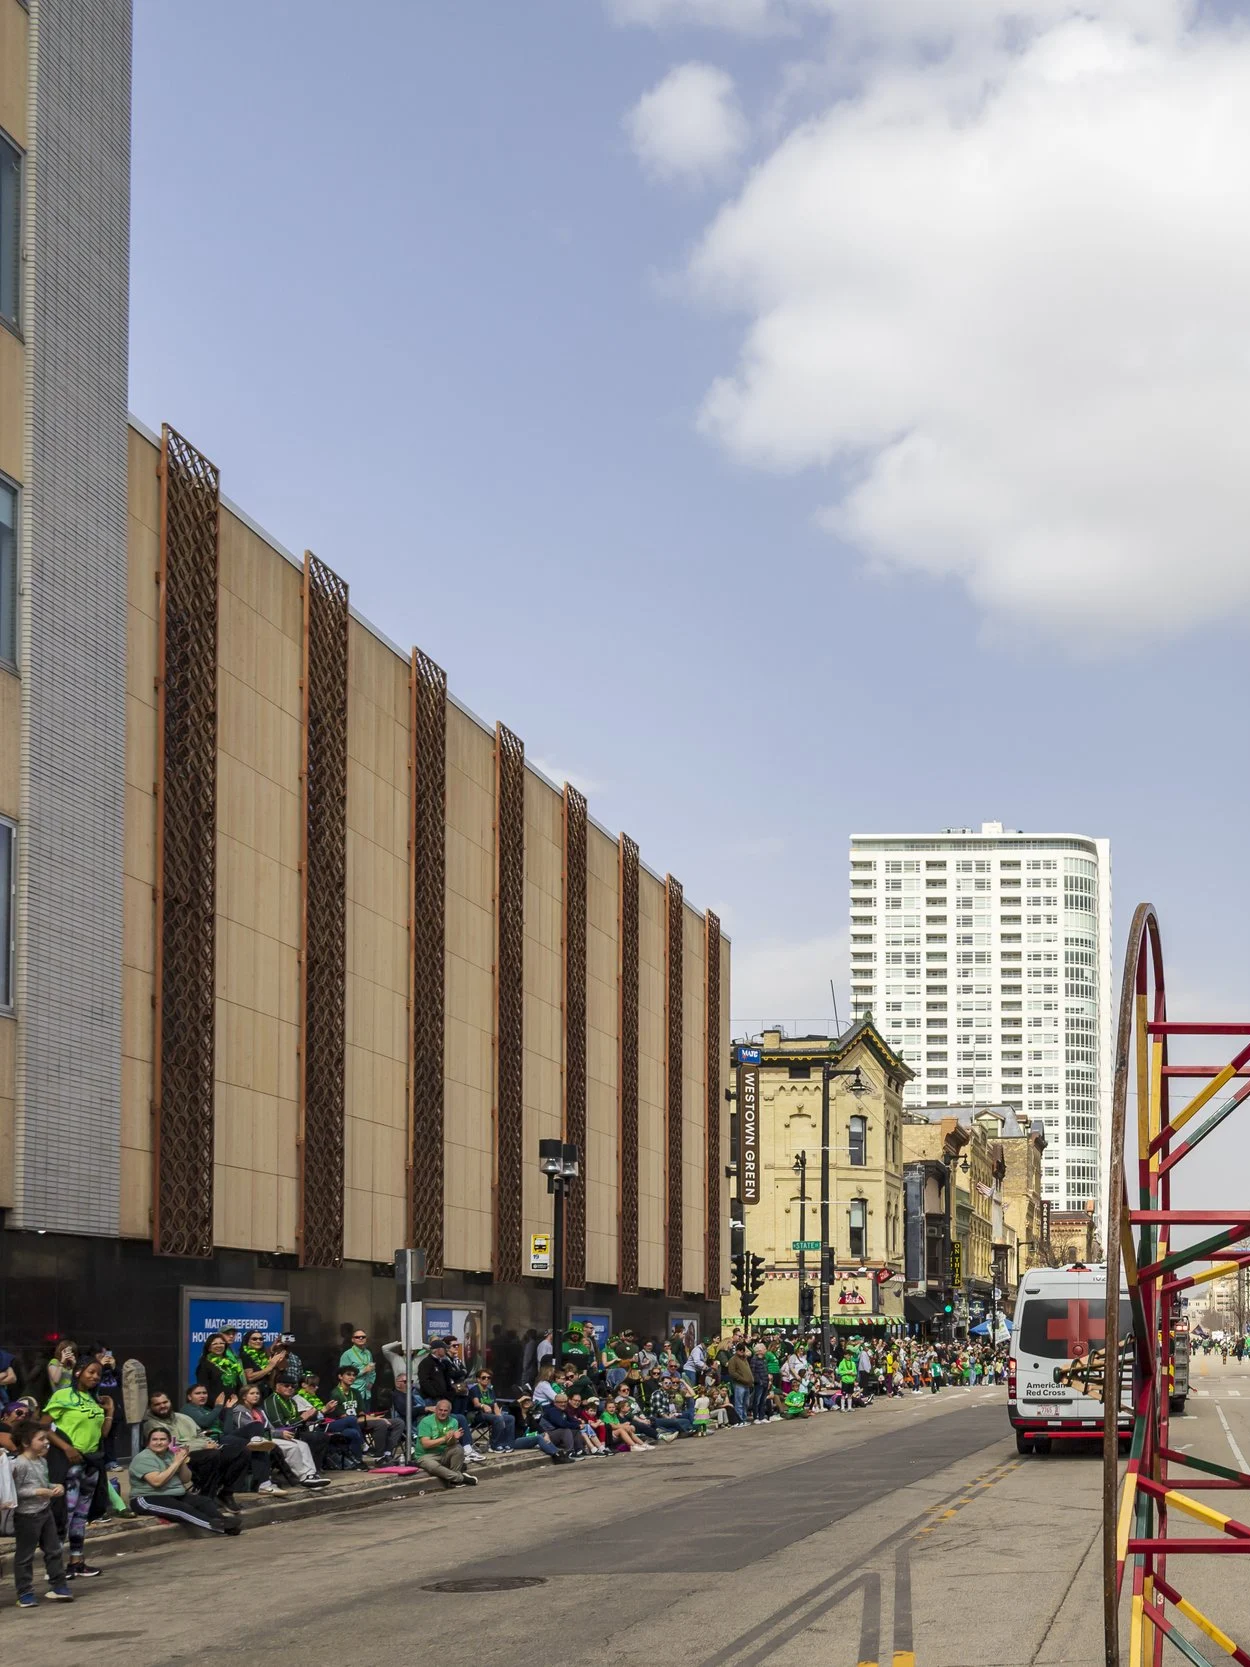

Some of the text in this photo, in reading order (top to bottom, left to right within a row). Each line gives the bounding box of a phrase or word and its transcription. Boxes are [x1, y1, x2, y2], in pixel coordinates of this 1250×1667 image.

[741, 1049, 758, 1058] MATC
[744, 1072, 756, 1198] WESTOWN GREEN
[204, 1318, 269, 1330] MATC PREFERRED
